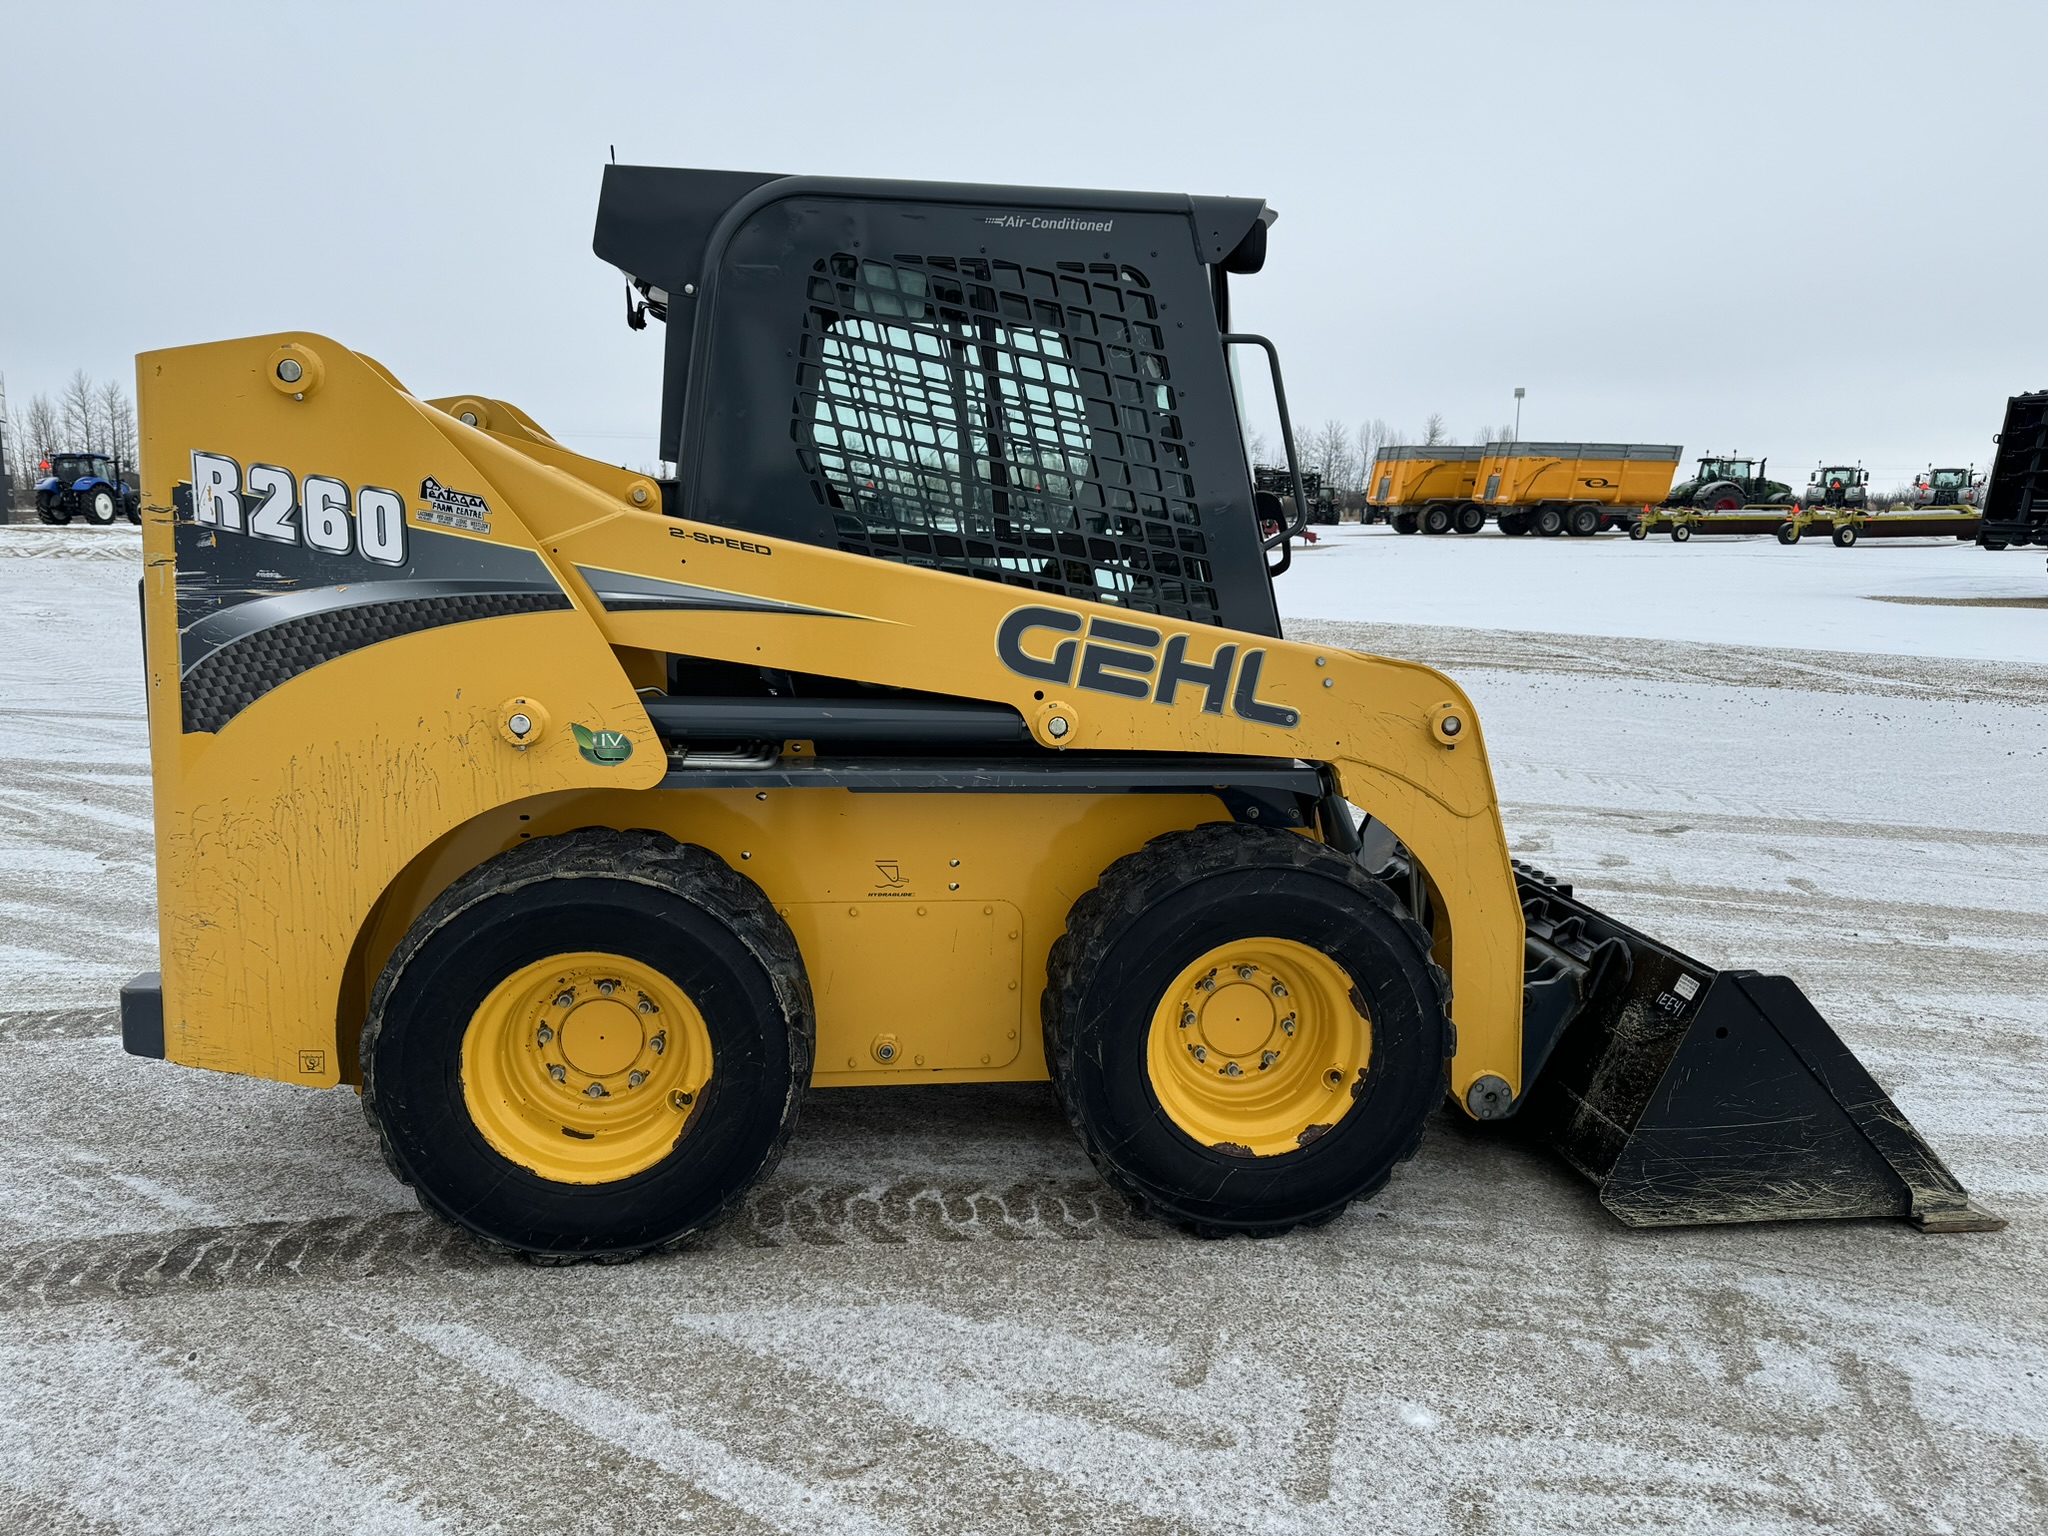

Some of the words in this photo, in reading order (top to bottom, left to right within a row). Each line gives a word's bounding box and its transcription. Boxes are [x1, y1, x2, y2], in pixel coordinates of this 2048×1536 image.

[1005, 215, 1113, 232] Air-Conditioned
[190, 449, 409, 567] R260
[432, 502, 453, 513] FARM
[456, 507, 482, 519] CENTRE
[669, 527, 772, 556] 2-SPEED
[994, 603, 1301, 729] GEHL
